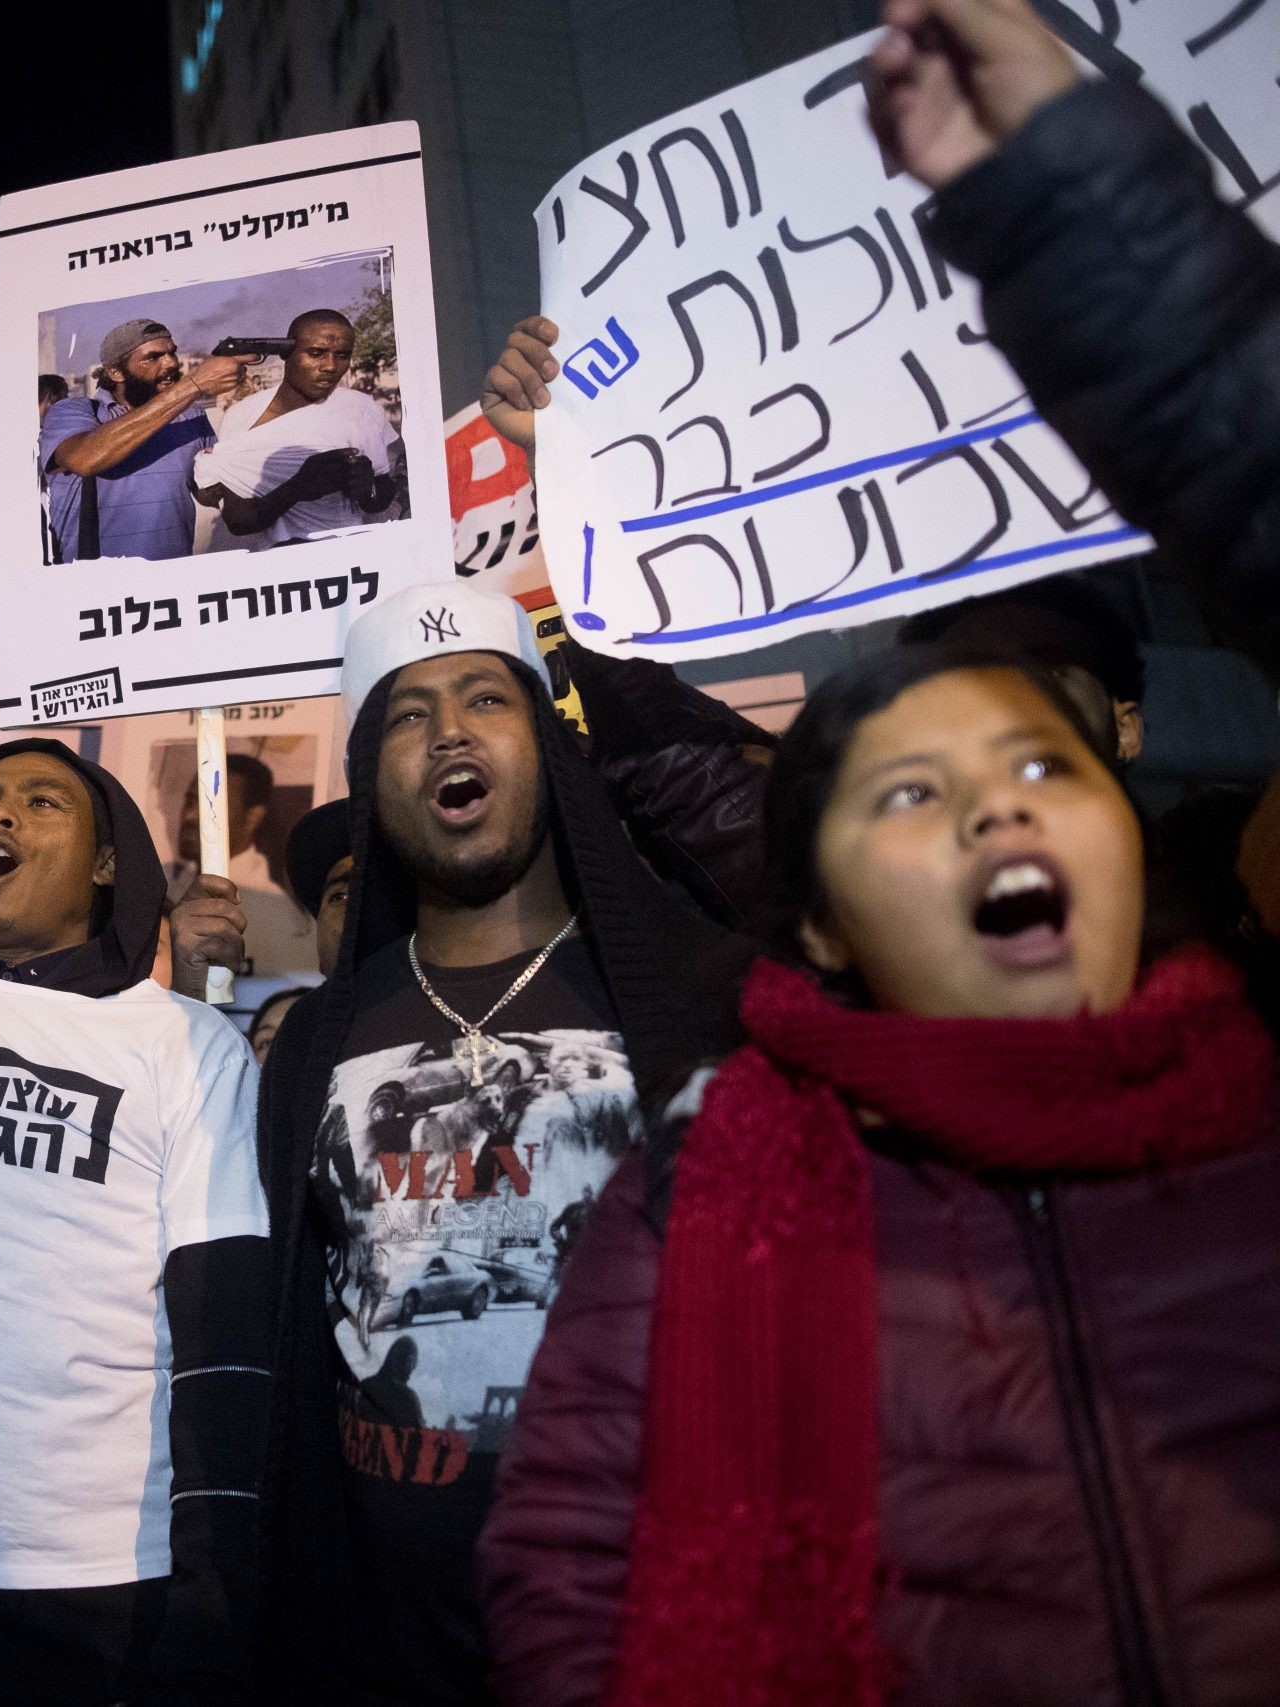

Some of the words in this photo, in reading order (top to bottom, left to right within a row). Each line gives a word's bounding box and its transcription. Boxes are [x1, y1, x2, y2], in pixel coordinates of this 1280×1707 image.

[68, 230, 193, 272] ברואנדה
[592, 383, 831, 510] כבר
[198, 567, 380, 625] לסחורה
[79, 596, 181, 642] בלוב
[42, 688, 61, 702] את
[64, 678, 109, 697] עוצרים
